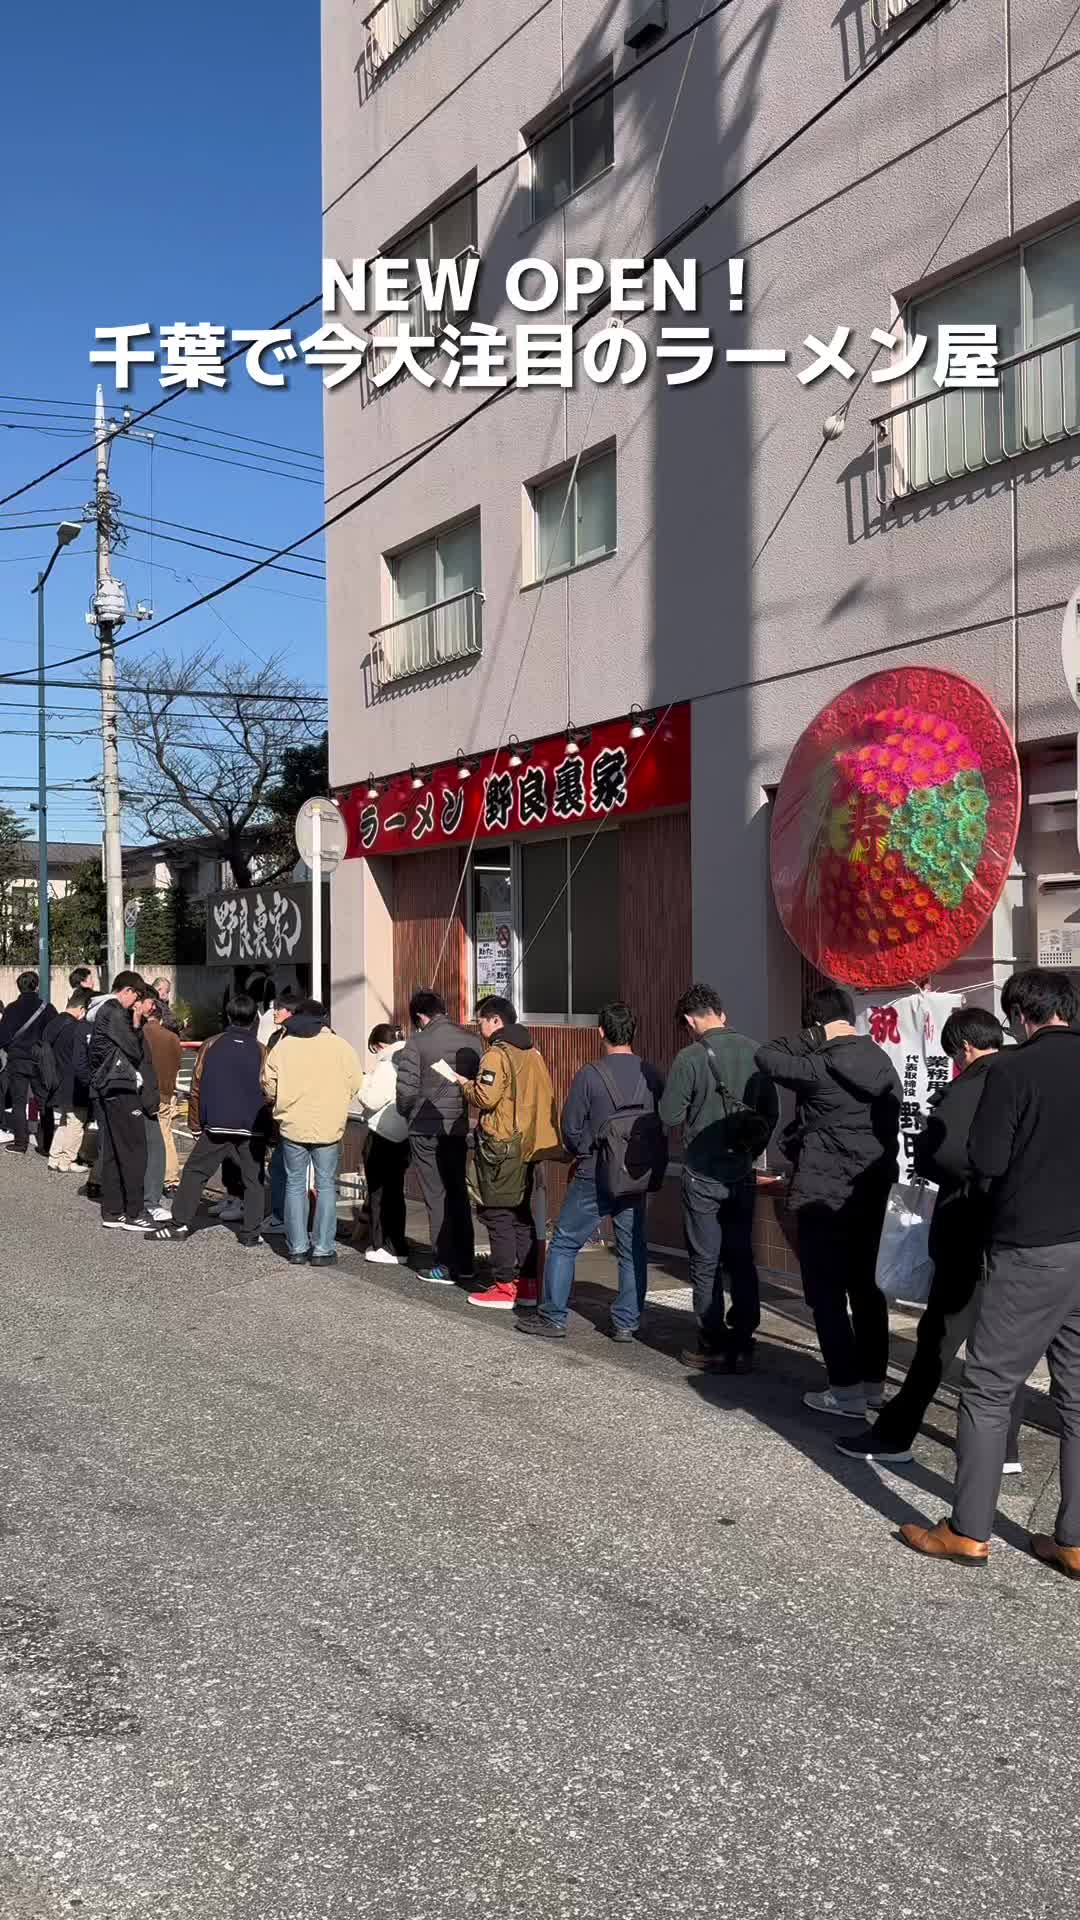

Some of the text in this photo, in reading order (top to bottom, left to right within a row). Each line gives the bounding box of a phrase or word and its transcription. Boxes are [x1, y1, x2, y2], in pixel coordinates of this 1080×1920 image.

[360, 747, 627, 848] ラーメン 野良裏家
[212, 890, 302, 959] 野良裏家
[869, 1005, 901, 1044] 祝
[903, 1054, 919, 1097] 代表取締役
